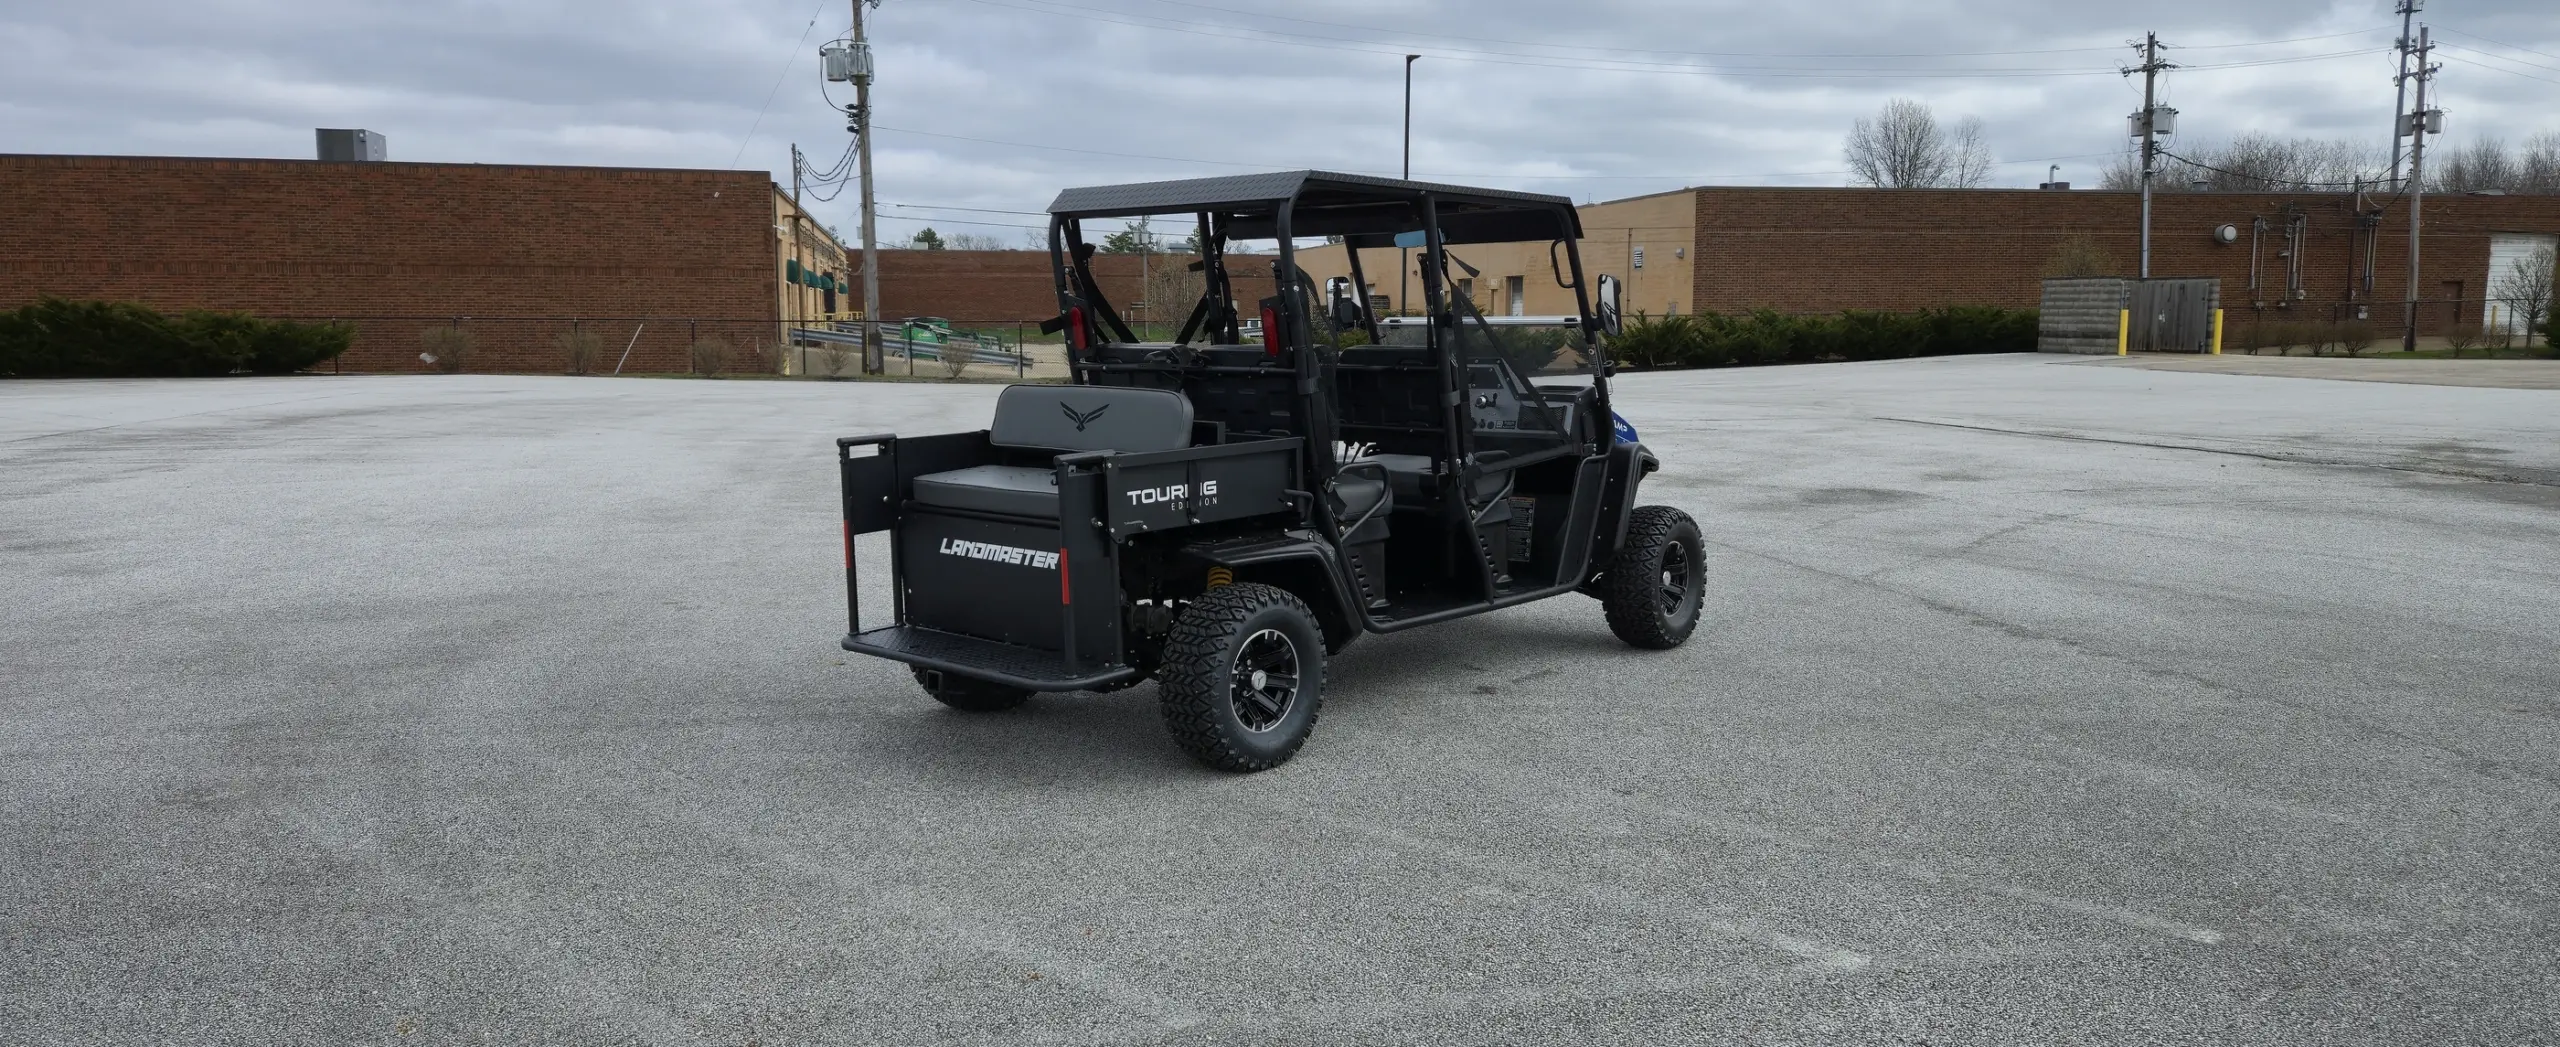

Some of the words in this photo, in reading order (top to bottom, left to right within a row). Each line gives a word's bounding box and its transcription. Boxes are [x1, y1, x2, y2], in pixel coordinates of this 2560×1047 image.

[1126, 480, 1217, 506] TOURIG
[1171, 497, 1218, 511] EDIION
[939, 537, 1060, 570] LANDMASTER
